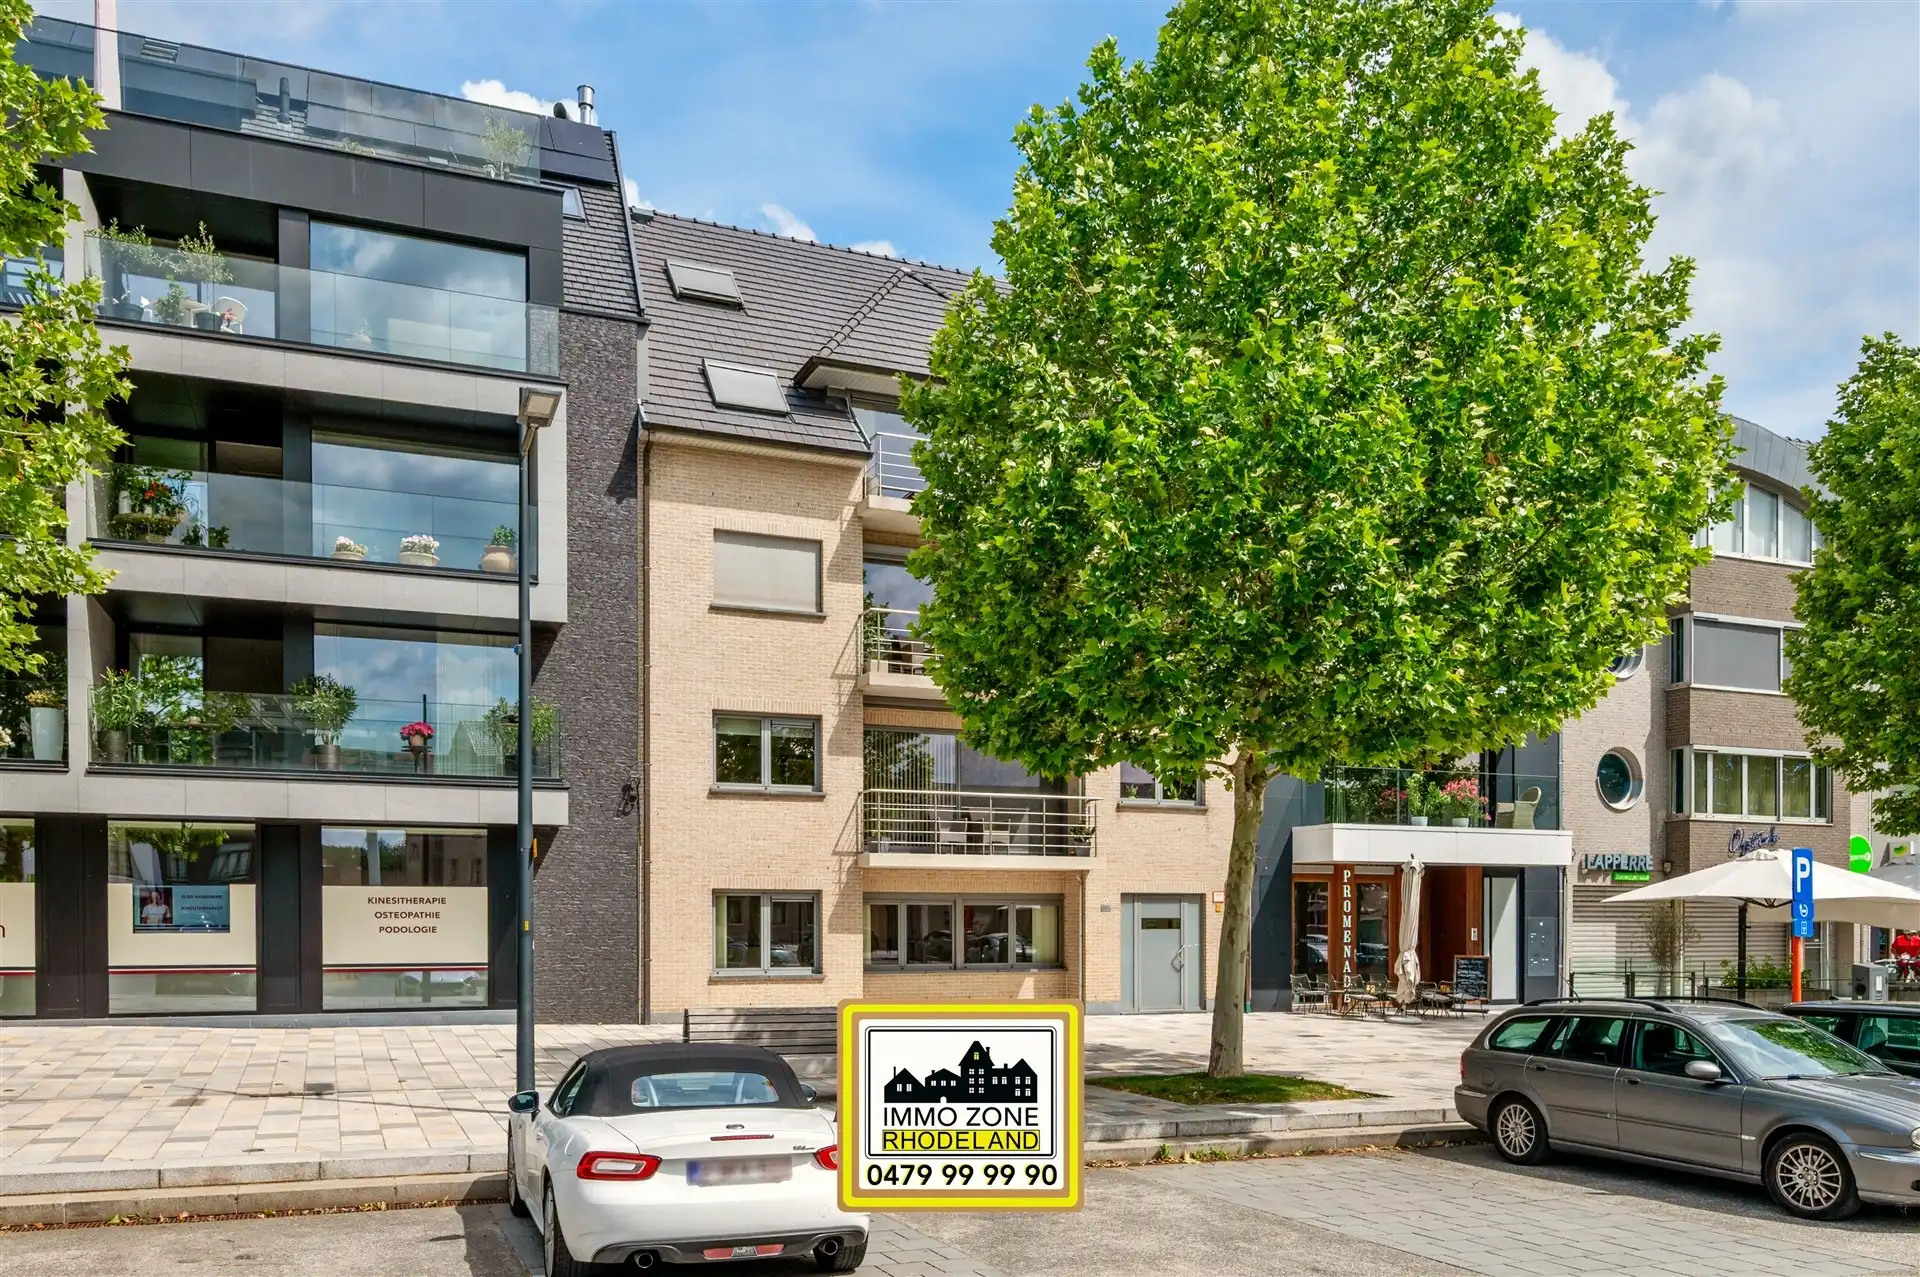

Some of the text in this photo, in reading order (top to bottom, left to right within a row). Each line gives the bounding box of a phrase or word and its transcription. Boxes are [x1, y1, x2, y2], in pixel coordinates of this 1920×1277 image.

[1585, 854, 1653, 871] LAPPERRE
[1796, 856, 1811, 893] P
[367, 896, 447, 905] KINESITHERAPIE
[374, 911, 441, 919] OSTEOPATHIE
[379, 926, 438, 934] PODOLOGIE
[1343, 869, 1352, 1003] PROMENADE
